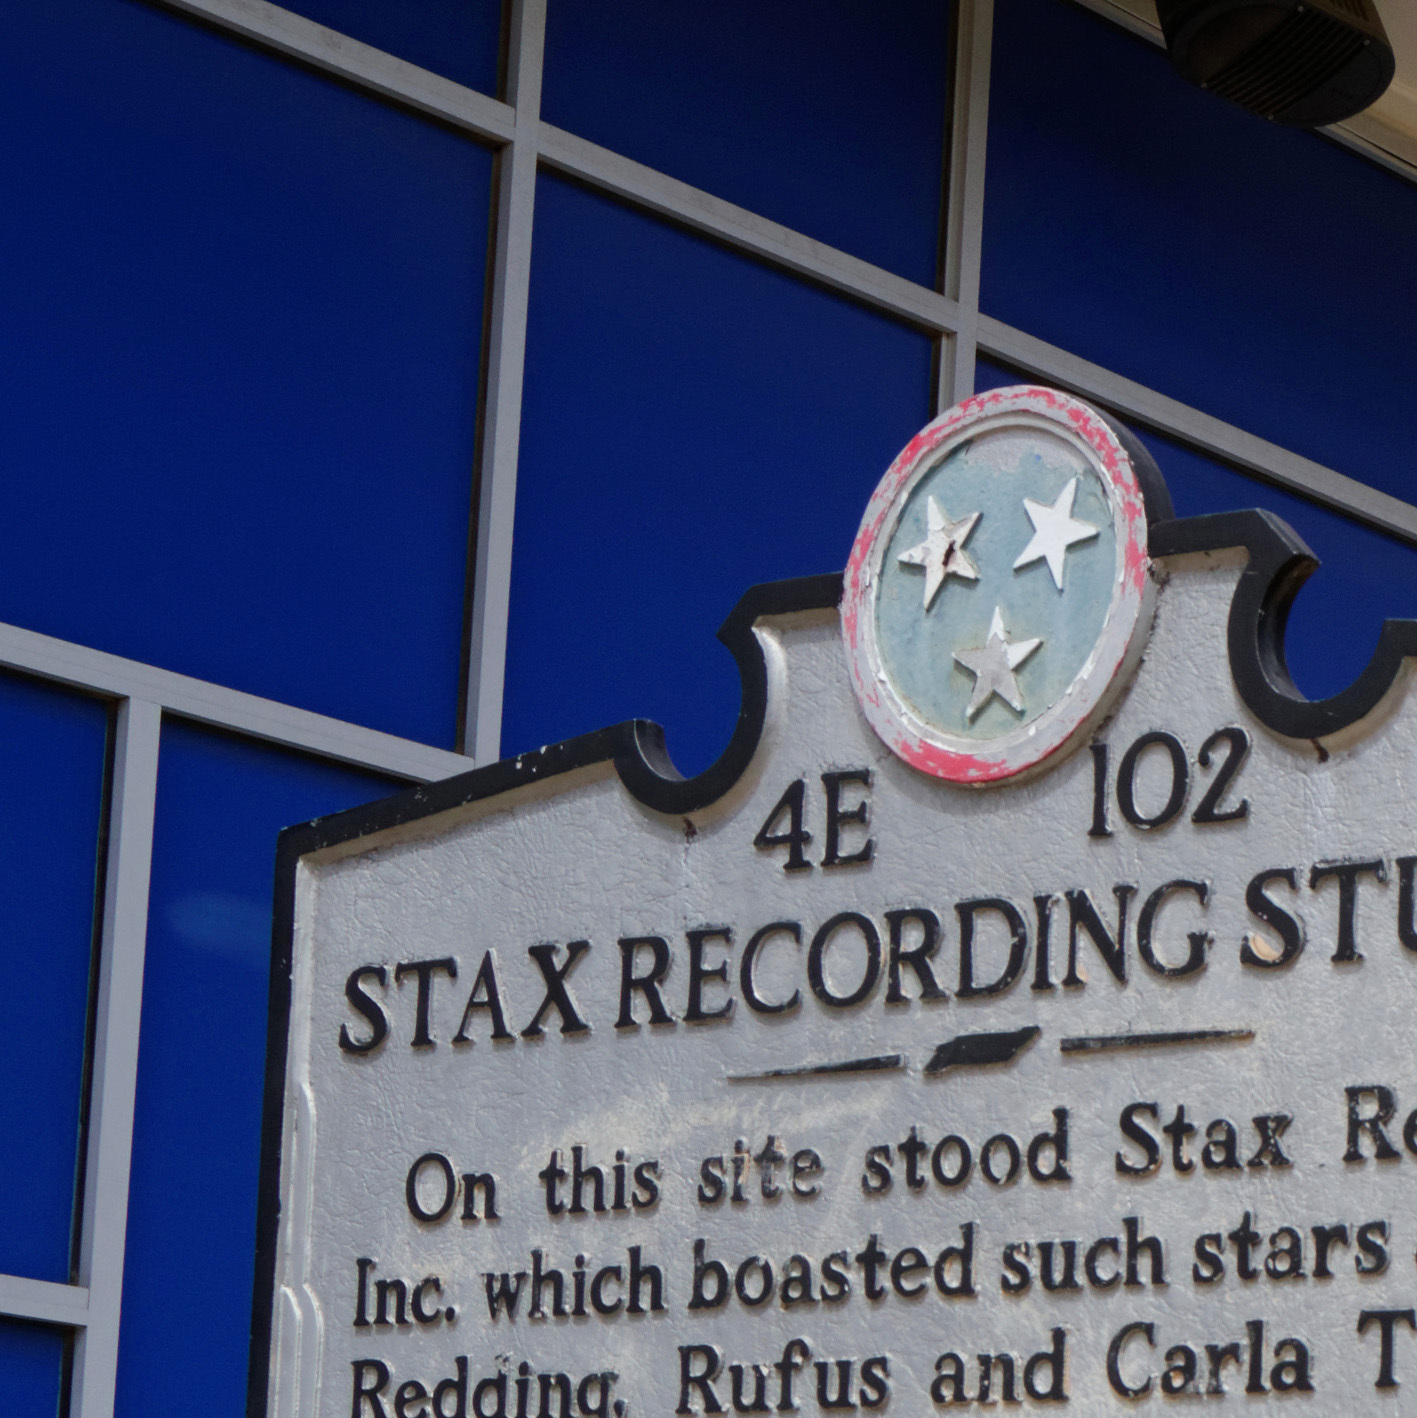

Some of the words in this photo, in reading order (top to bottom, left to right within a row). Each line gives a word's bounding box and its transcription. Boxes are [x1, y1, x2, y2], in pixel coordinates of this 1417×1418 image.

[754, 769, 876, 871] 4E
[1088, 726, 1251, 837] 102
[338, 940, 593, 1053] STAX
[613, 878, 1214, 1030] RECORDING
[405, 1151, 499, 1222] On
[540, 1143, 661, 1217] this
[698, 1135, 824, 1205] site
[861, 1106, 1072, 1193] stood
[1115, 1102, 1294, 1177] Stax
[352, 1258, 457, 1327] Inc.
[482, 1245, 666, 1319] which
[687, 1221, 979, 1310] boasted
[1000, 1216, 1166, 1294] such
[1191, 1212, 1389, 1284] stars
[675, 1338, 891, 1415] Rufus
[930, 1327, 1071, 1402] and
[1106, 1319, 1314, 1397] Carla
